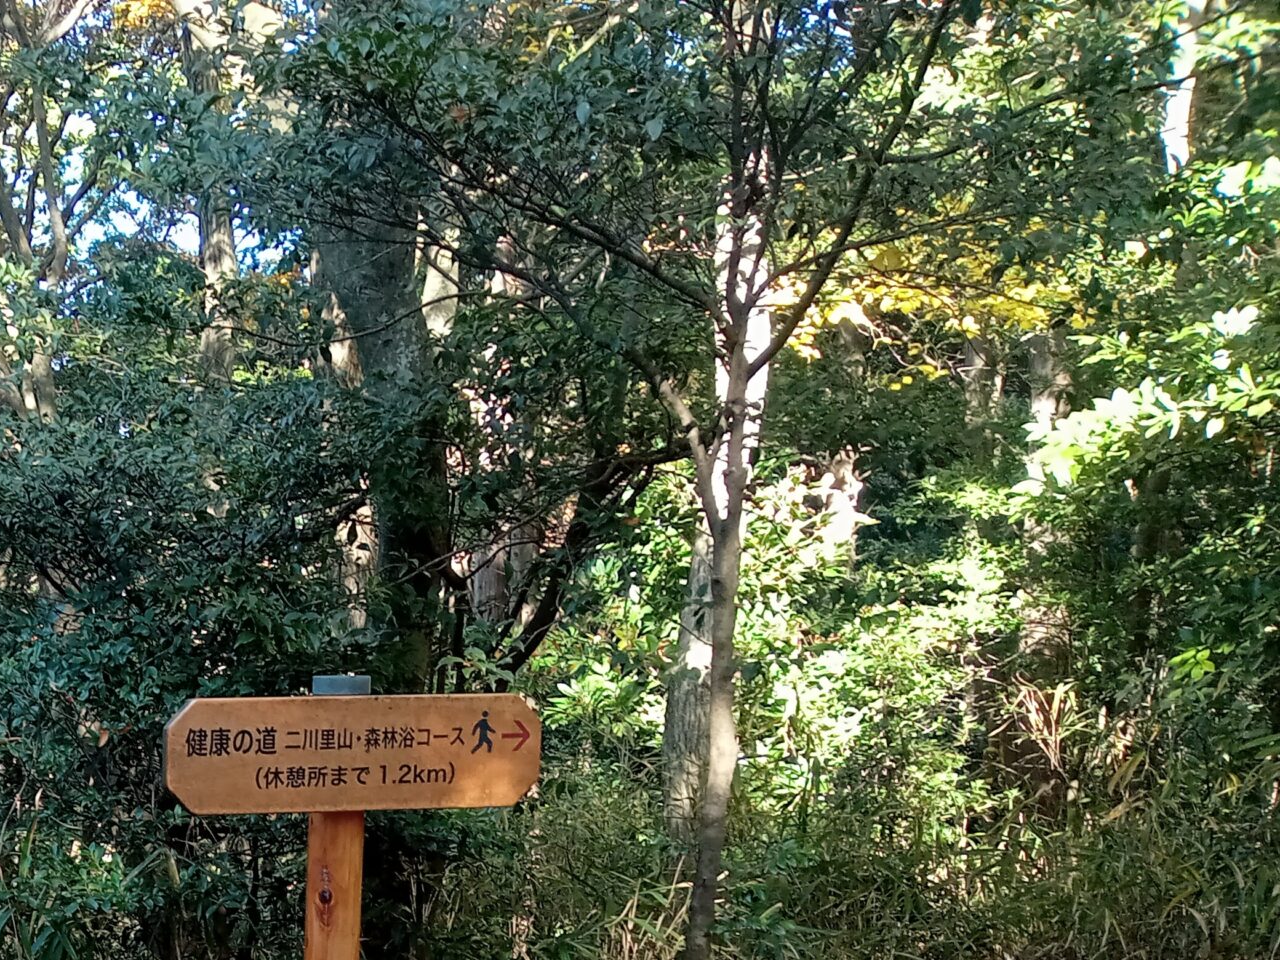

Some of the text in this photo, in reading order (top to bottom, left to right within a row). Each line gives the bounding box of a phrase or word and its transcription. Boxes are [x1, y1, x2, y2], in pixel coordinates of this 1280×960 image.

[185, 727, 278, 757] 健康の道
[379, 761, 455, 786] 1.2km)
